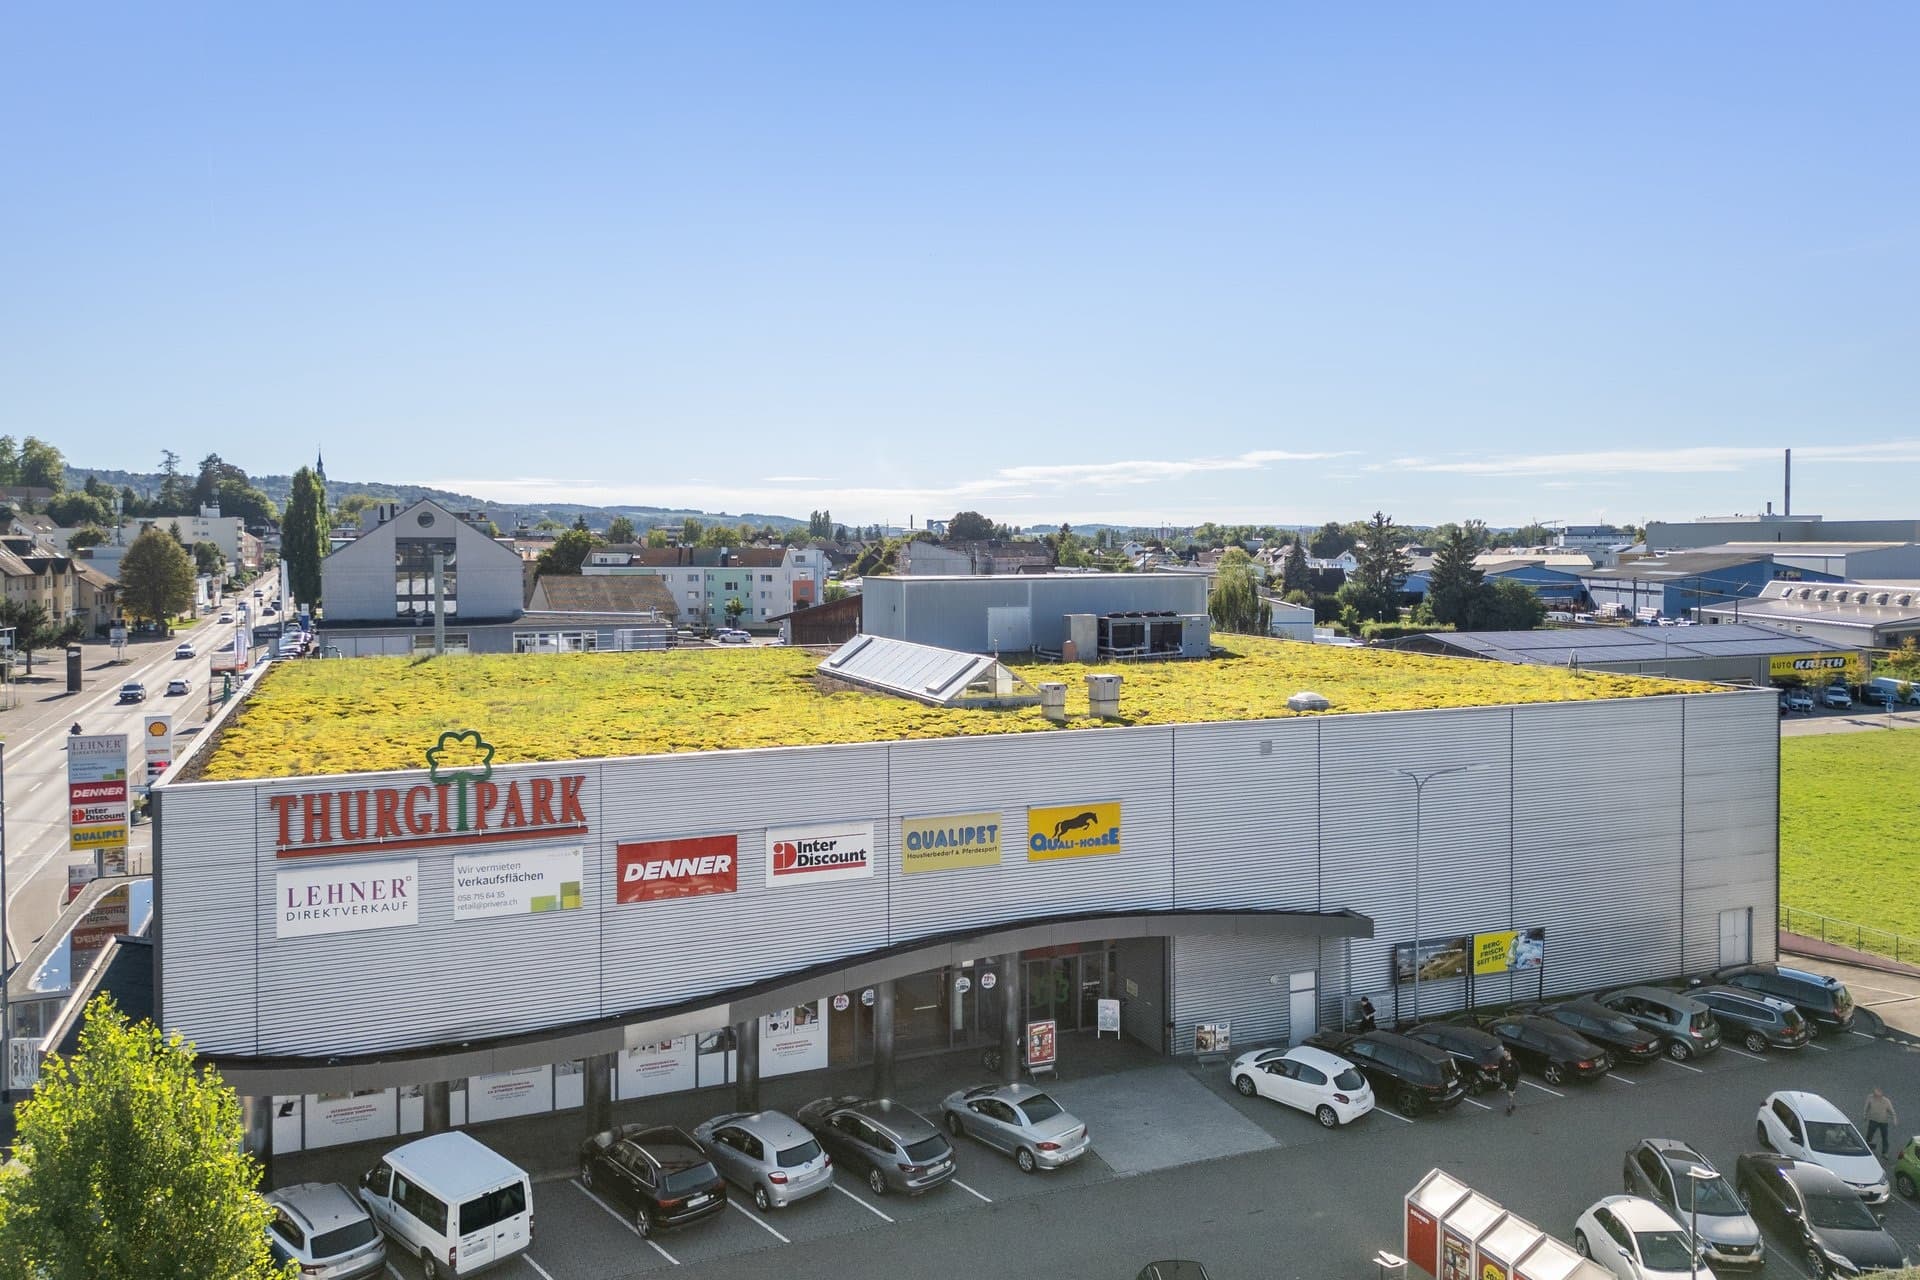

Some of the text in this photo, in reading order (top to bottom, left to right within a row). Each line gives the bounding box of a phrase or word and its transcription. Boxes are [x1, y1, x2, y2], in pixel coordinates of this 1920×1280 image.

[72, 740, 121, 750] LEHNER
[72, 786, 124, 798] DENNER
[474, 775, 587, 829] PARK
[86, 812, 125, 821] Discount
[73, 830, 125, 841] QUALIPET
[907, 824, 998, 850] QUALIPET
[1030, 827, 1120, 852] QUALI-HORSE
[797, 840, 837, 854] Inter
[907, 850, 954, 860] Haustierbedarf
[962, 846, 998, 855] Pferdesport
[797, 848, 867, 867] Discount
[457, 862, 521, 874] Wir vermieten
[623, 855, 731, 882] DENNER
[458, 871, 544, 887] Verkaufsflächen
[287, 878, 408, 908] LEHNER
[457, 893, 471, 902] 058
[486, 891, 495, 899] 64
[286, 901, 408, 921] DIREKTVERKAUF
[457, 898, 518, 911] retail@privera.ch
[1483, 940, 1503, 950] BERG-
[1480, 946, 1504, 958] FRISCH
[1477, 957, 1490, 966] SEIT
